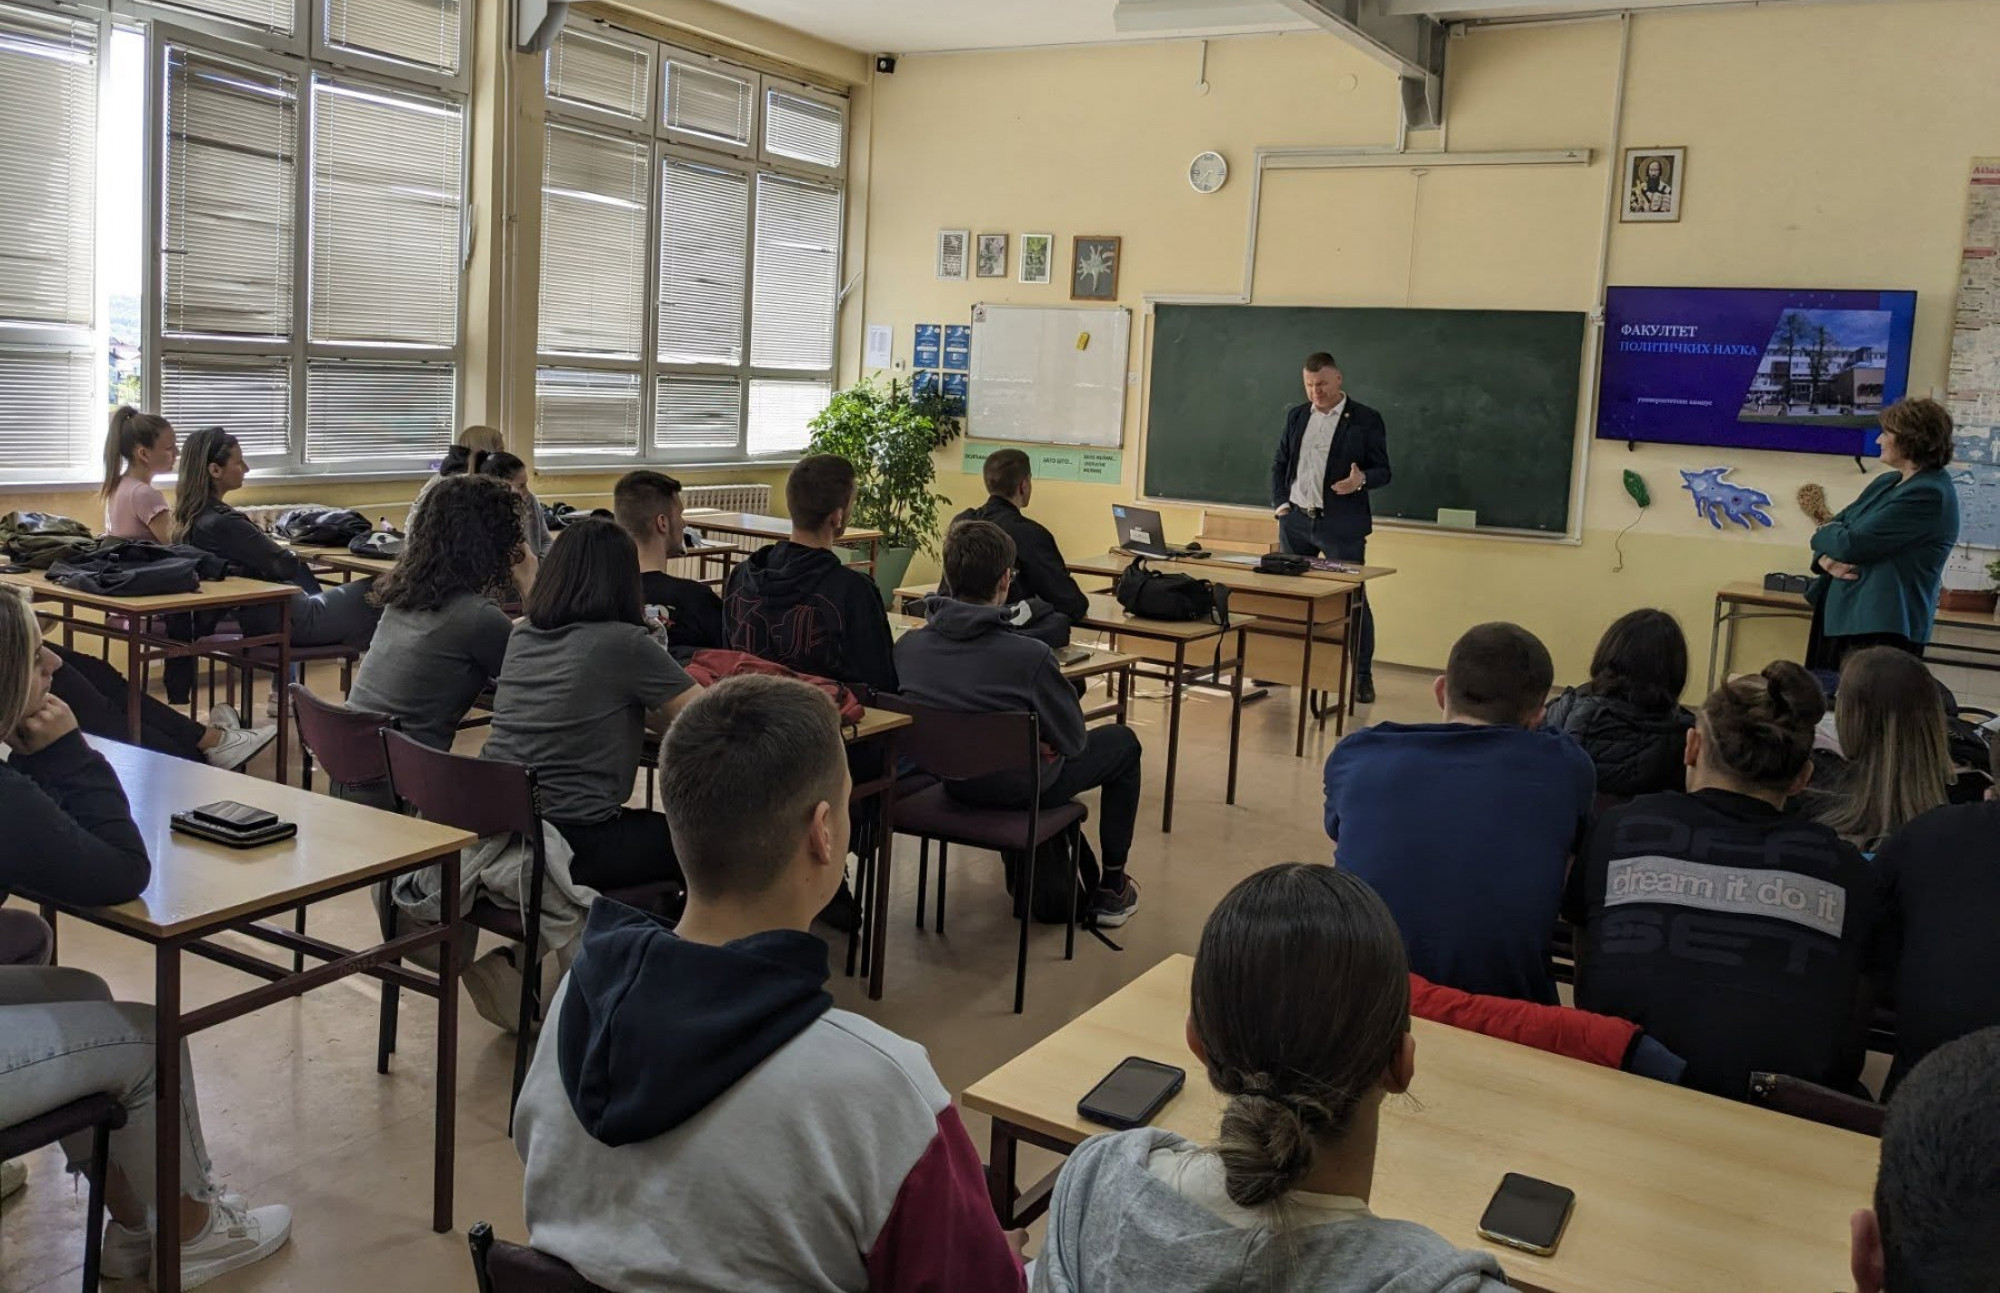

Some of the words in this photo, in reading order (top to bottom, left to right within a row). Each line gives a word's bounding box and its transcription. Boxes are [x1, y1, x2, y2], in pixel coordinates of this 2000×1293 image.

[1621, 324, 1698, 337] ФАКУЛТЕТ
[1619, 341, 1710, 354] ПОЛИТИЧКИХ
[1713, 343, 1758, 356] НАУКА
[1612, 866, 1714, 899] dream
[1724, 874, 1749, 904] it
[1757, 878, 1807, 911] do
[1816, 889, 1838, 921] it
